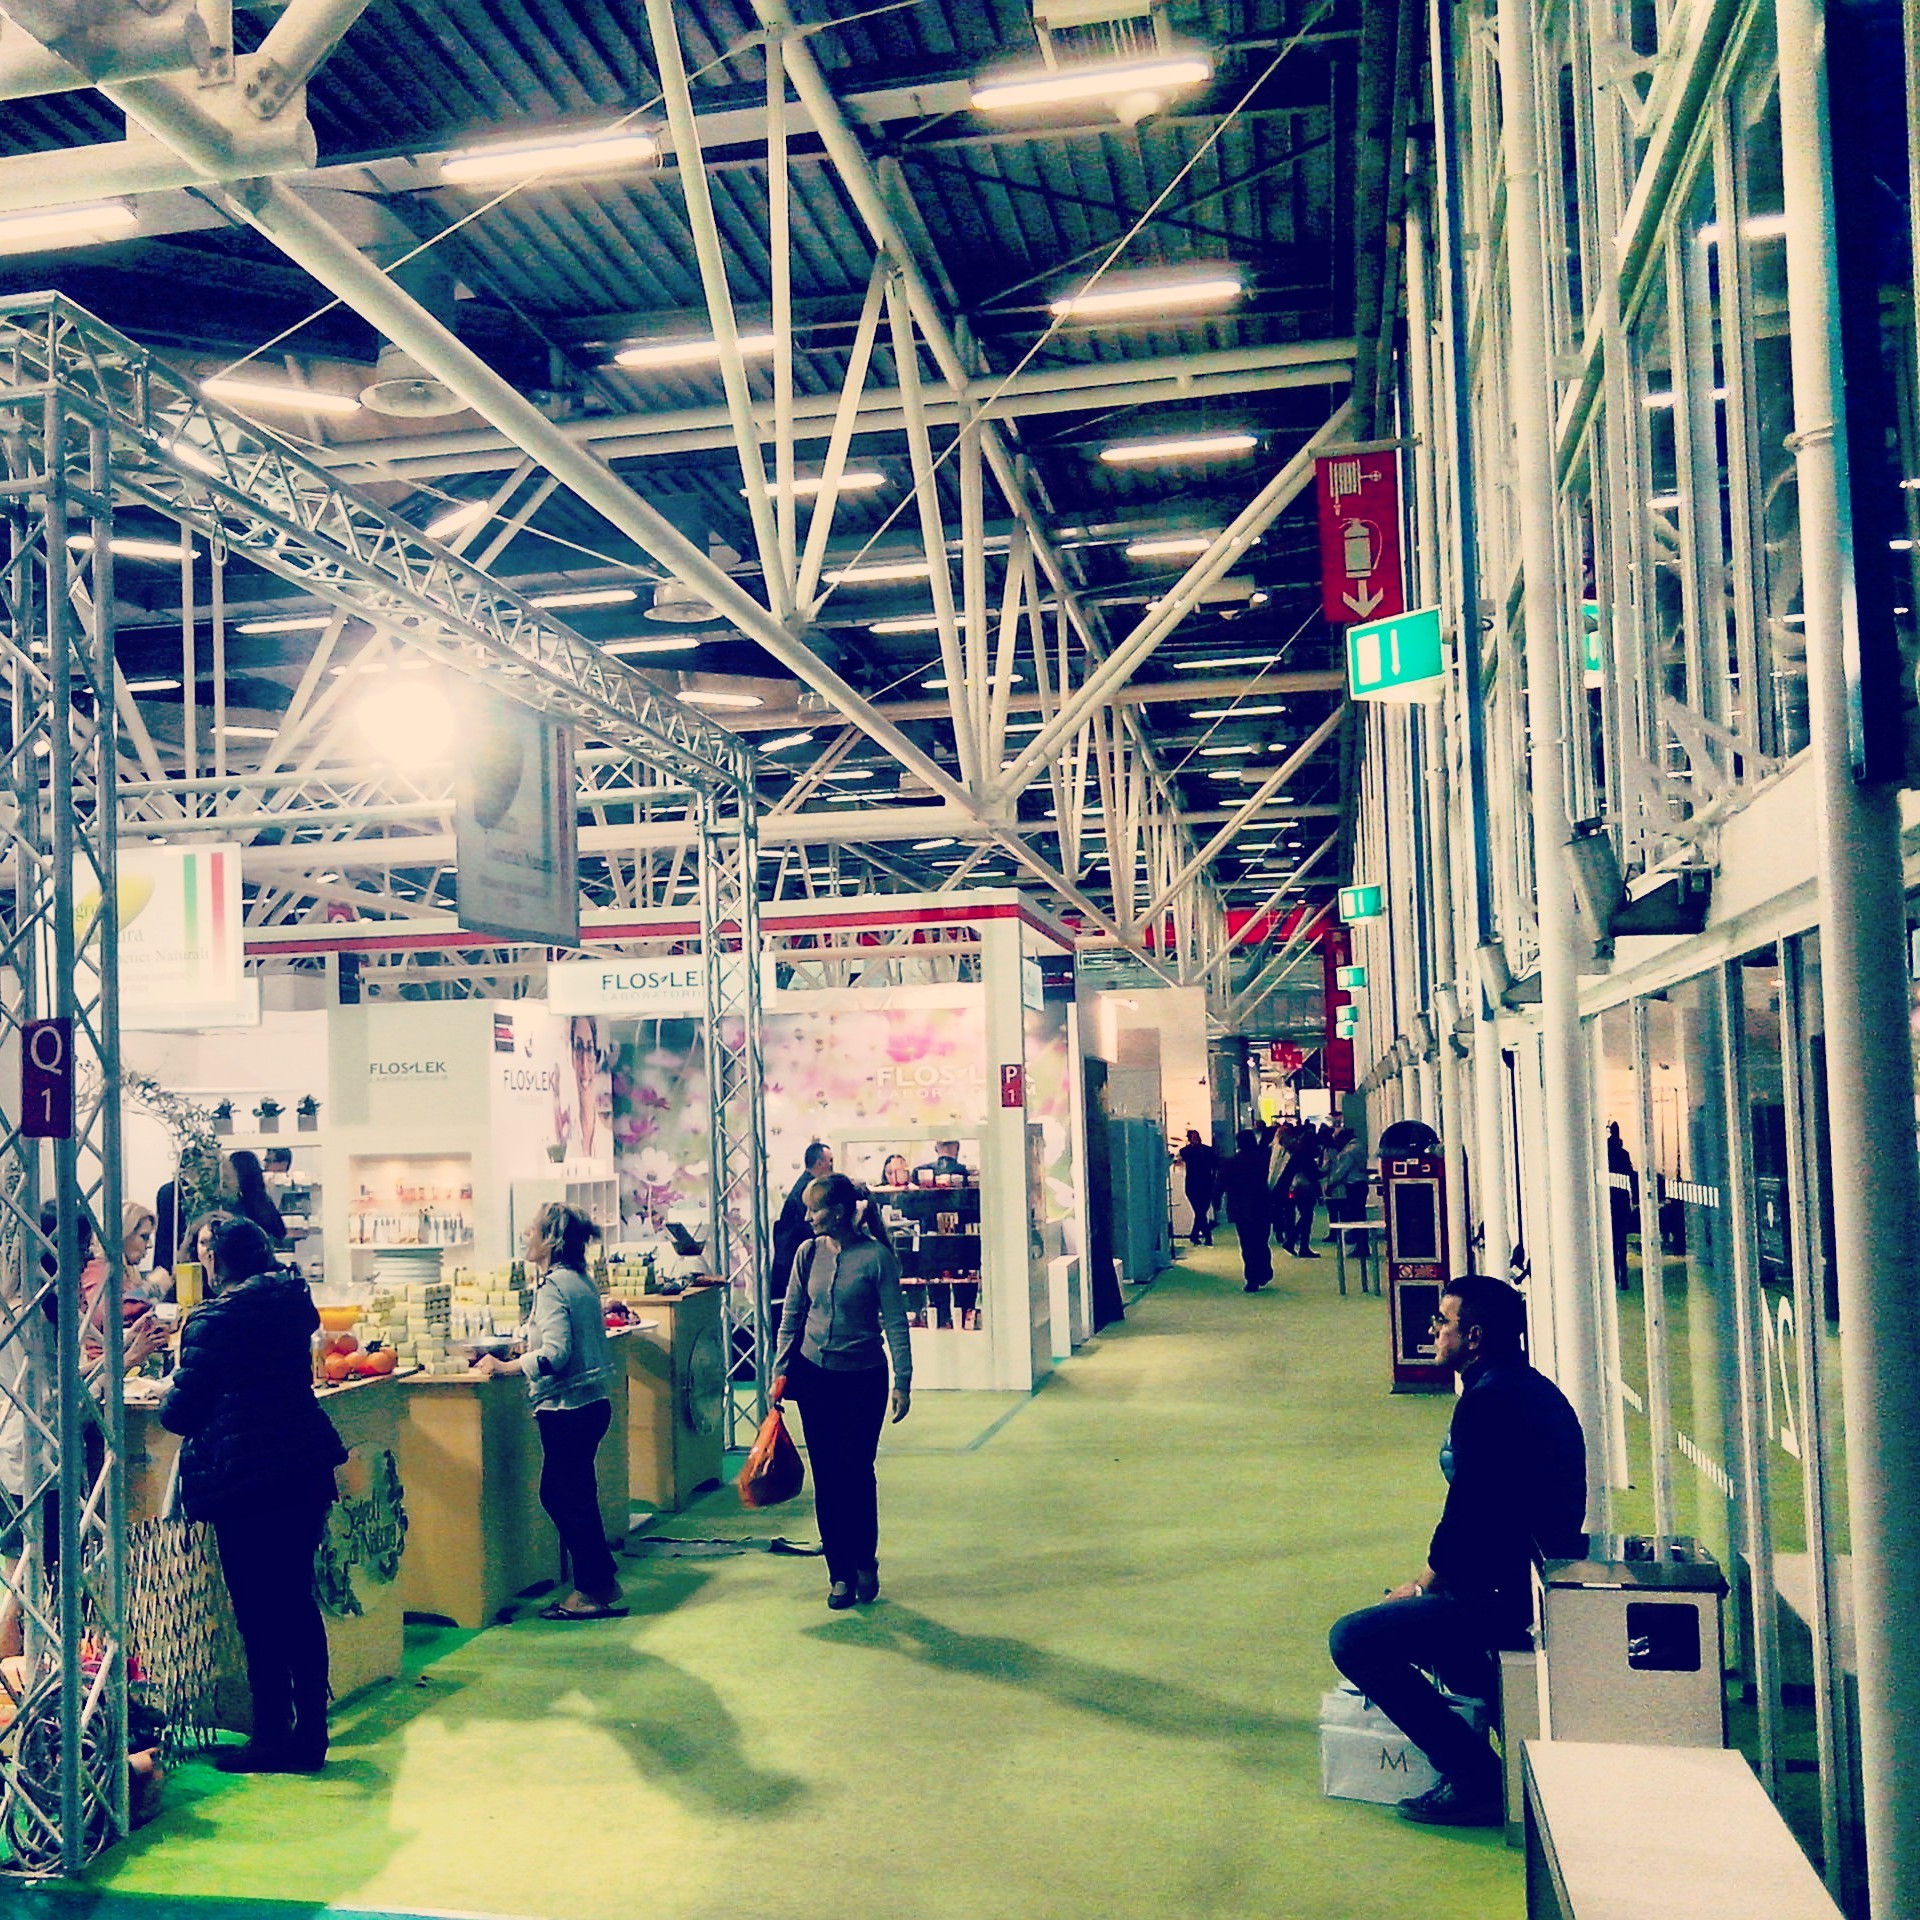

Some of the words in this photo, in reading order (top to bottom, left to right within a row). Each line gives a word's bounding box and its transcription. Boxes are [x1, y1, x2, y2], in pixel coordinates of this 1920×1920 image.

[30, 1025, 63, 1077] Q
[1004, 1065, 1018, 1084] P
[41, 1087, 51, 1123] 1
[1008, 1089, 1016, 1104] 1
[1379, 1746, 1409, 1773] M
